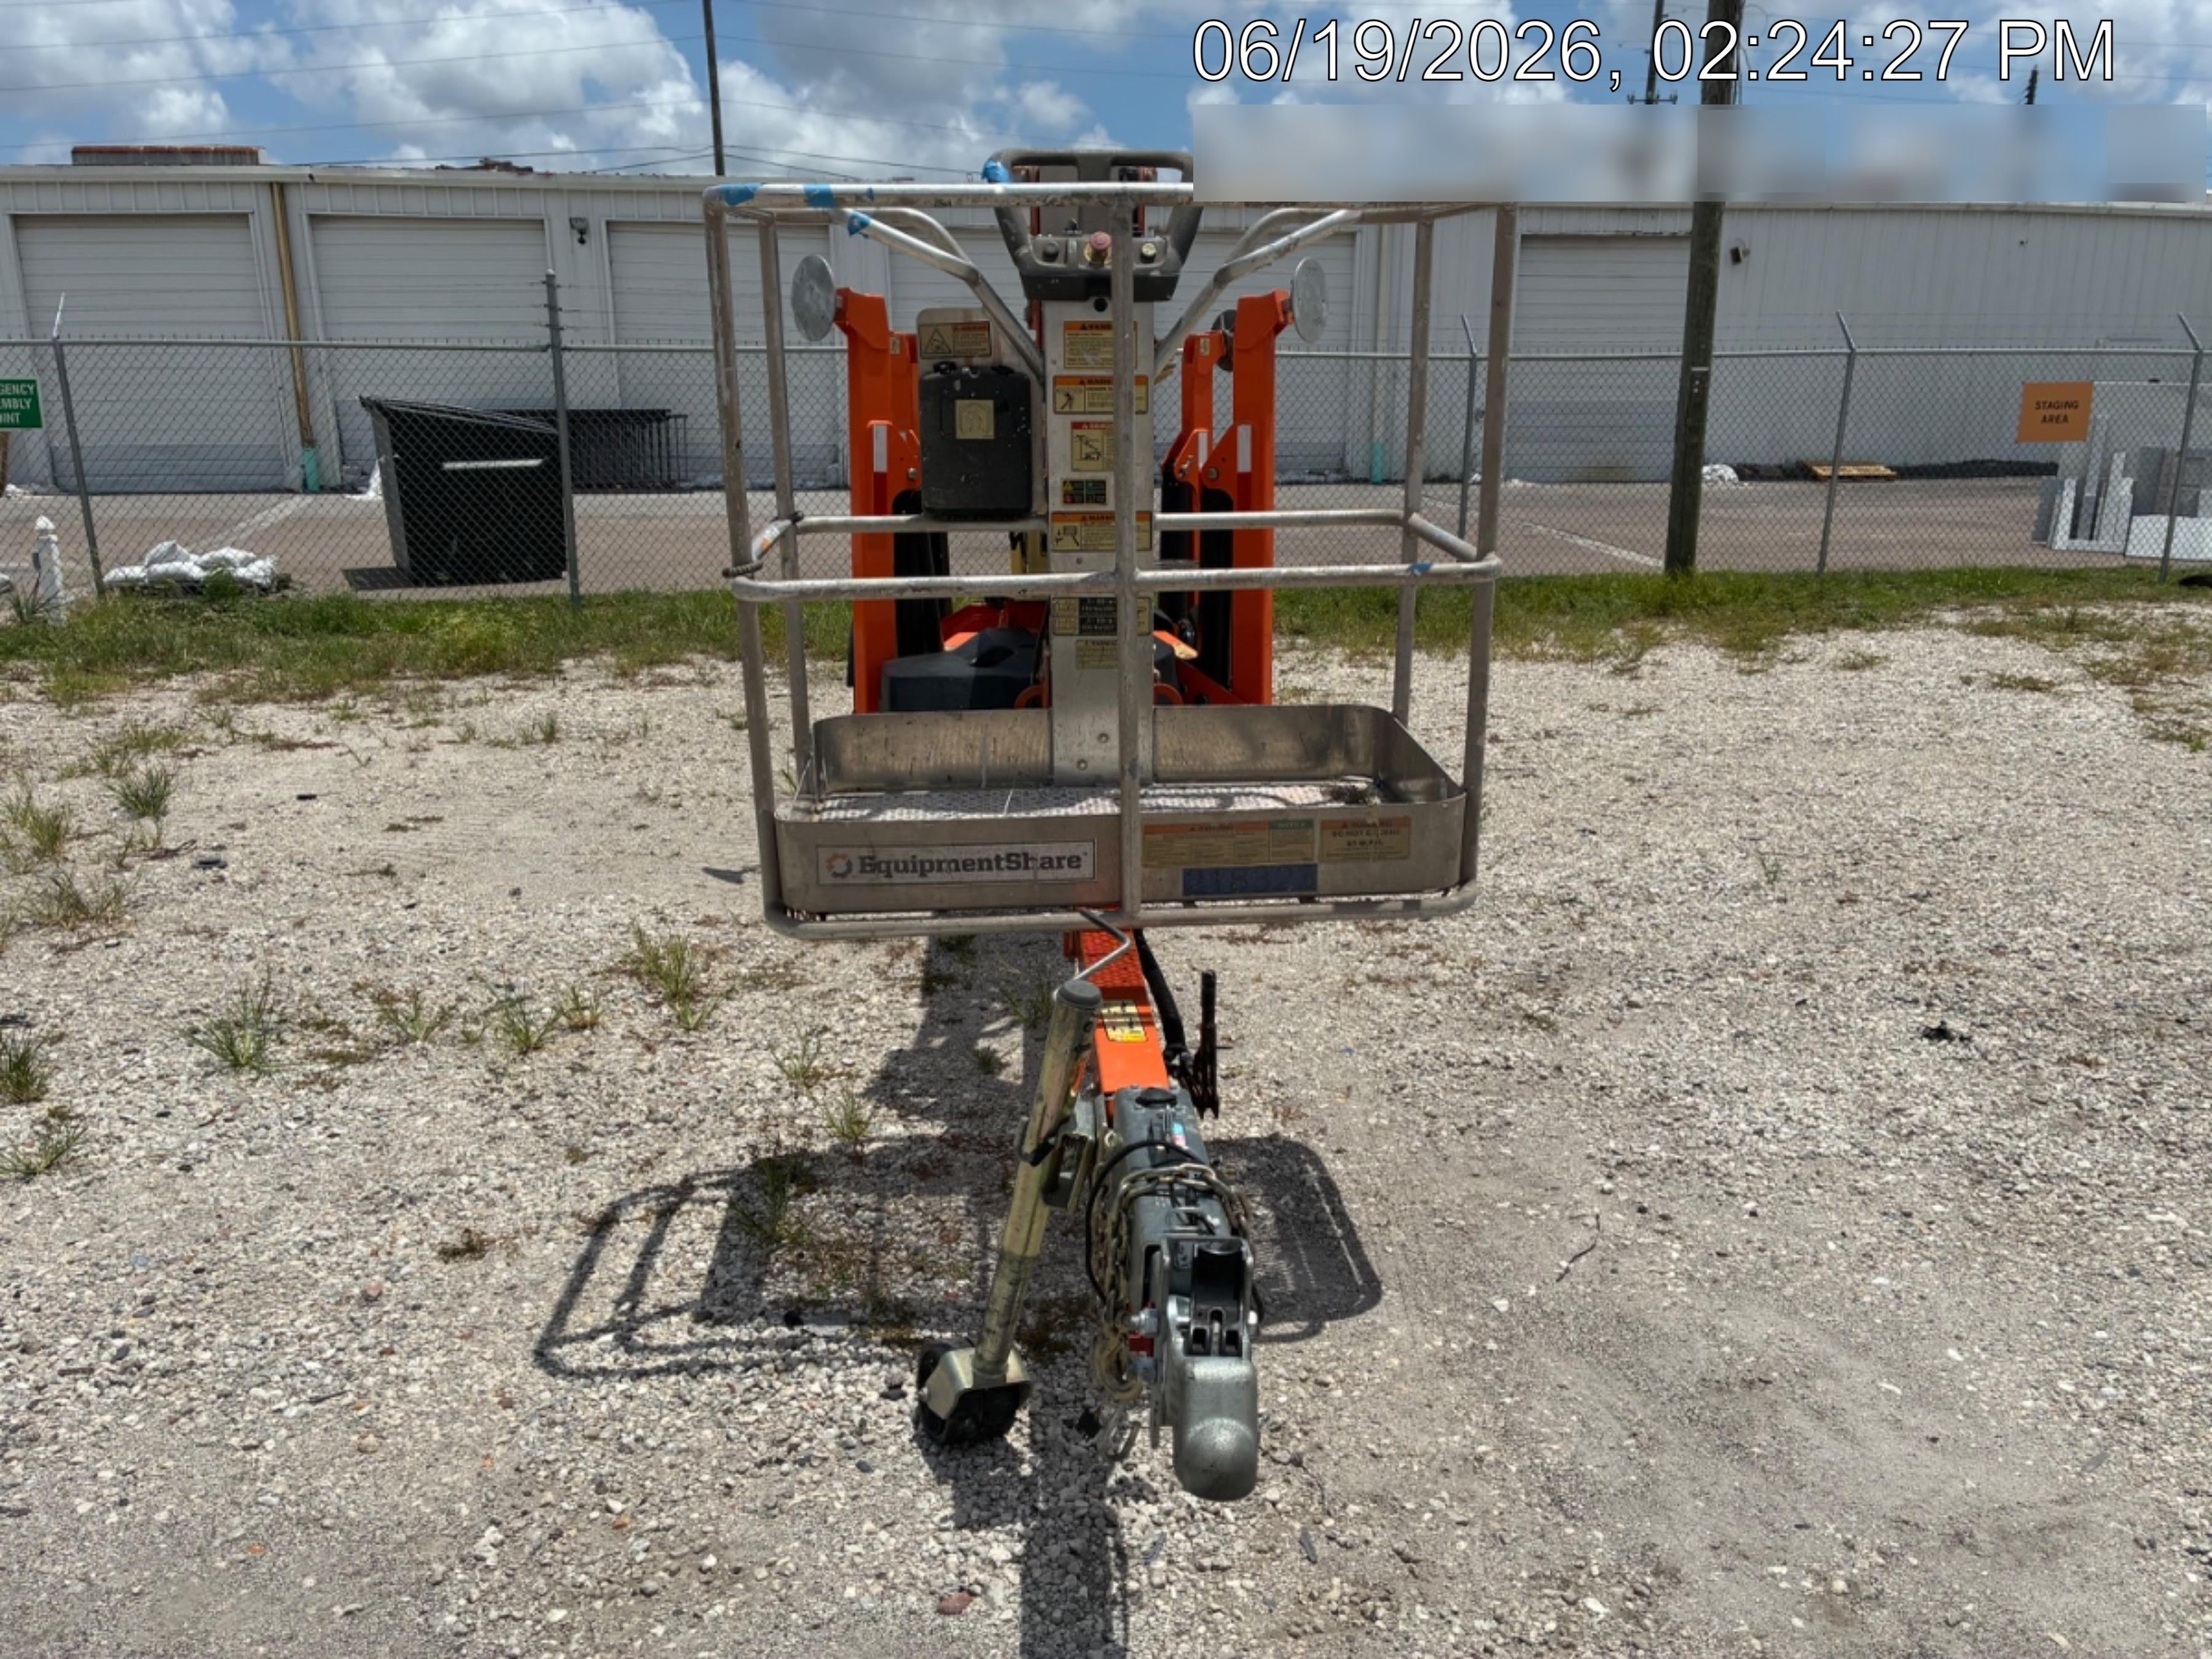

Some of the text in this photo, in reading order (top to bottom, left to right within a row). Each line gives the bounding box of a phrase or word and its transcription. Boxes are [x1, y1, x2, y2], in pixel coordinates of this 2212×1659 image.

[0, 398, 32, 410] MBLY
[2034, 400, 2078, 410] STAGING
[2040, 414, 2069, 424] AREA
[858, 852, 1082, 878] EquipmentShare
